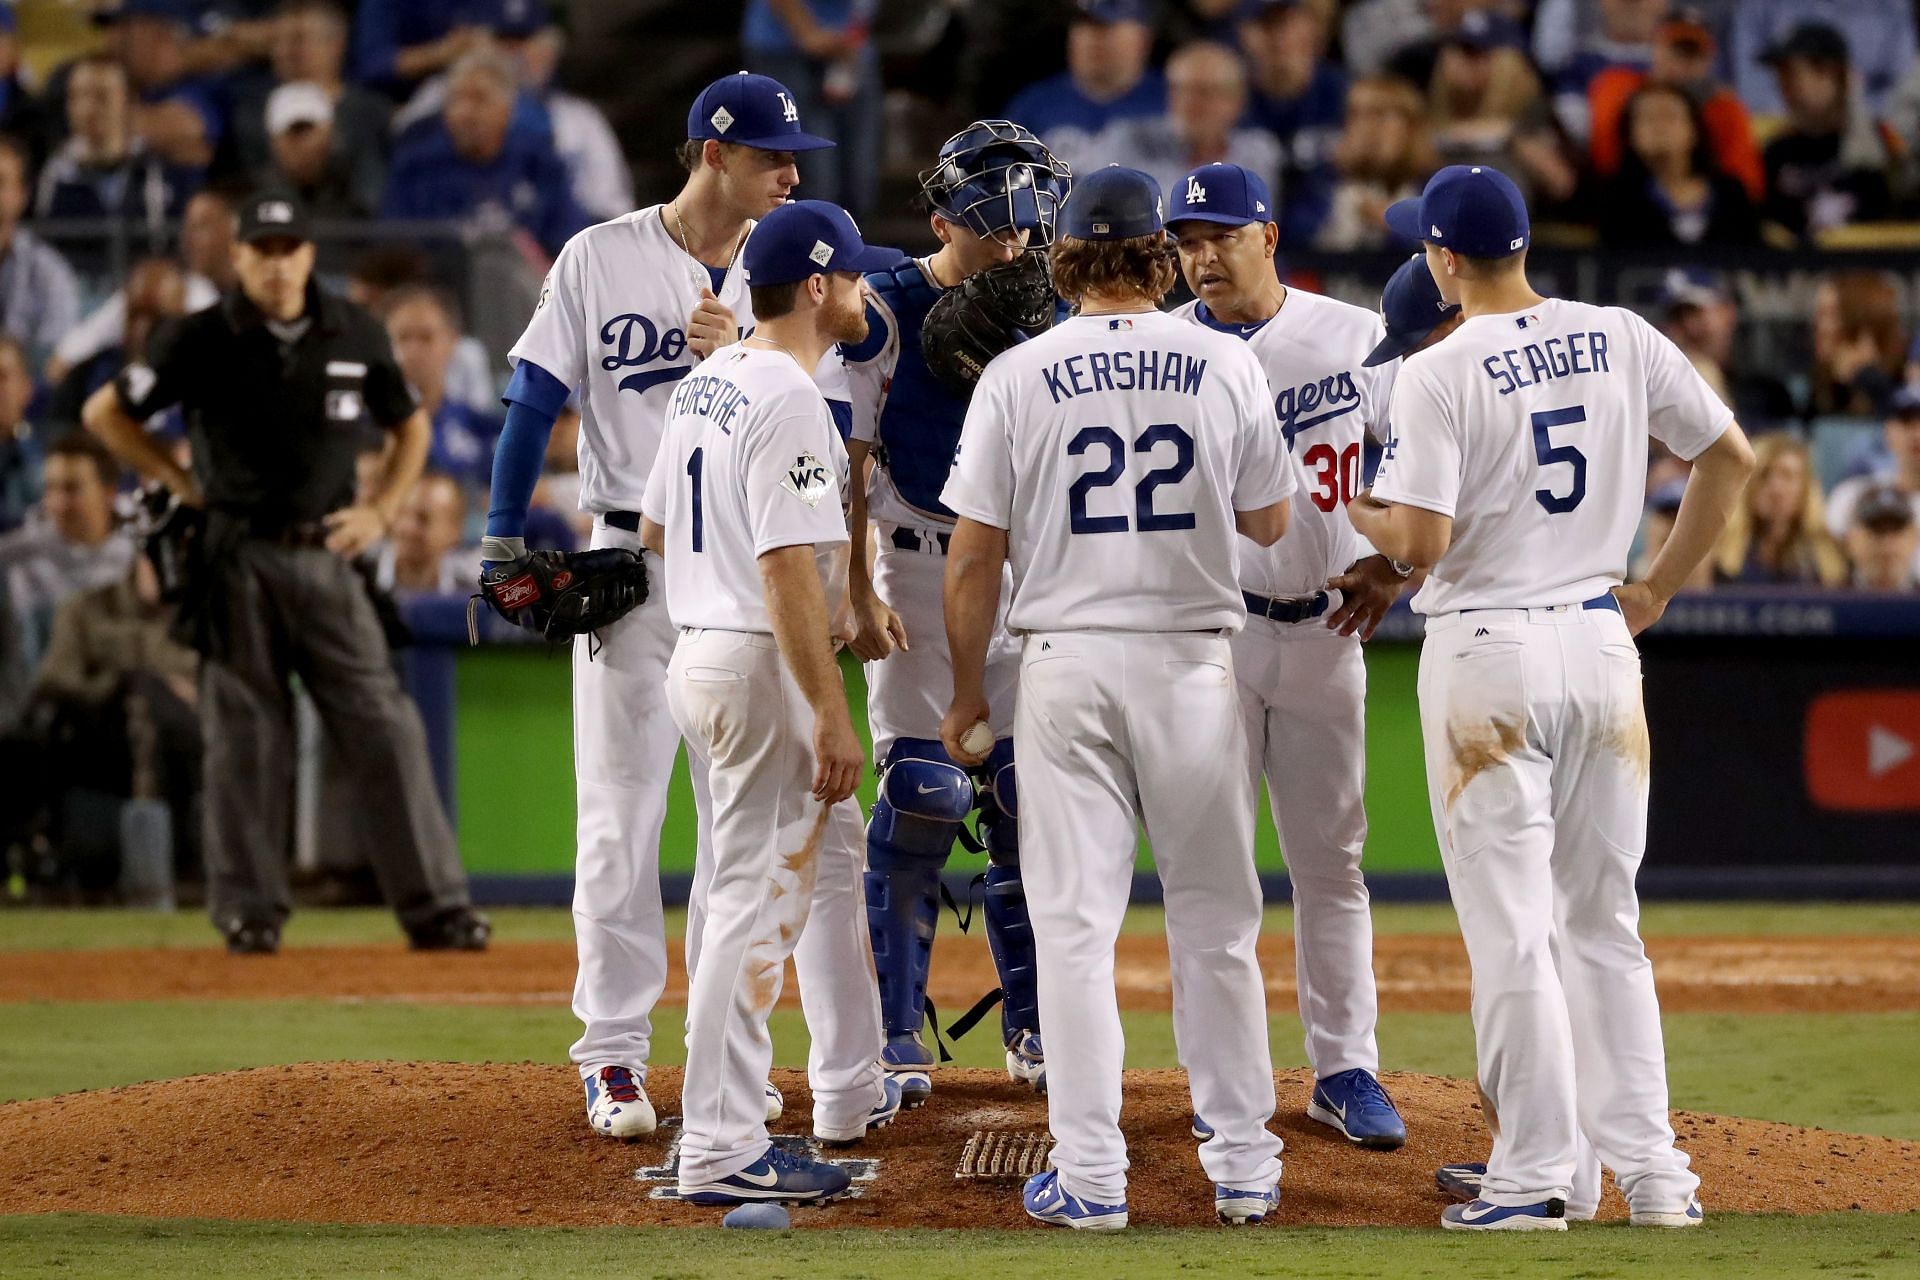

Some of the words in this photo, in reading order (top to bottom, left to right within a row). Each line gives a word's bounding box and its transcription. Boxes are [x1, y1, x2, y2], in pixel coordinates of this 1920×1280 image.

[777, 93, 798, 122] LA
[1185, 175, 1207, 204] LA
[1041, 350, 1208, 405] KERSHAW
[1483, 332, 1610, 396] SEAGER
[672, 375, 750, 437] FORSYTHE
[1275, 370, 1361, 454] gers
[788, 467, 827, 491] WS
[1067, 423, 1196, 535] 22
[1303, 442, 1360, 513] 30
[1530, 405, 1588, 515] 5
[686, 446, 704, 553] 1
